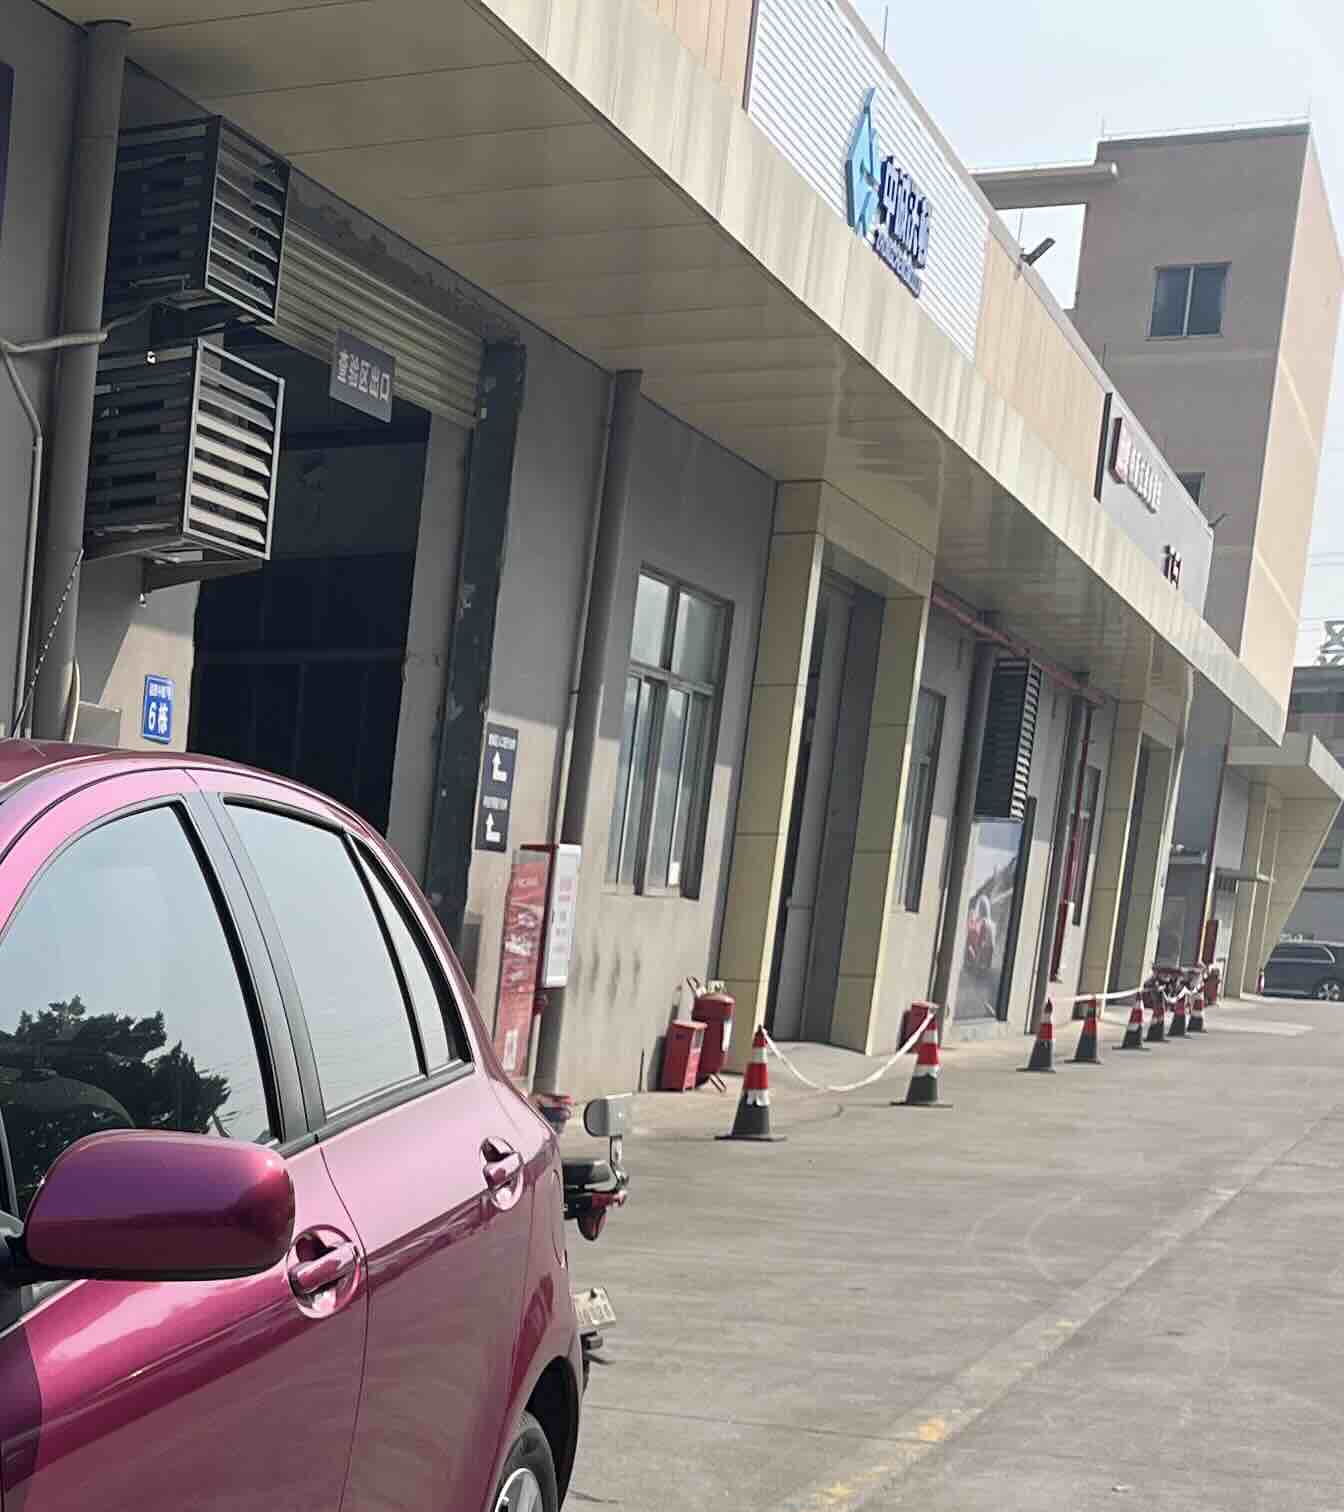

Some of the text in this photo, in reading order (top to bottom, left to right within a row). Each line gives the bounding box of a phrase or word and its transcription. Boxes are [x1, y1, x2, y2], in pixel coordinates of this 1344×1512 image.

[337, 349, 391, 401] 查验区出口
